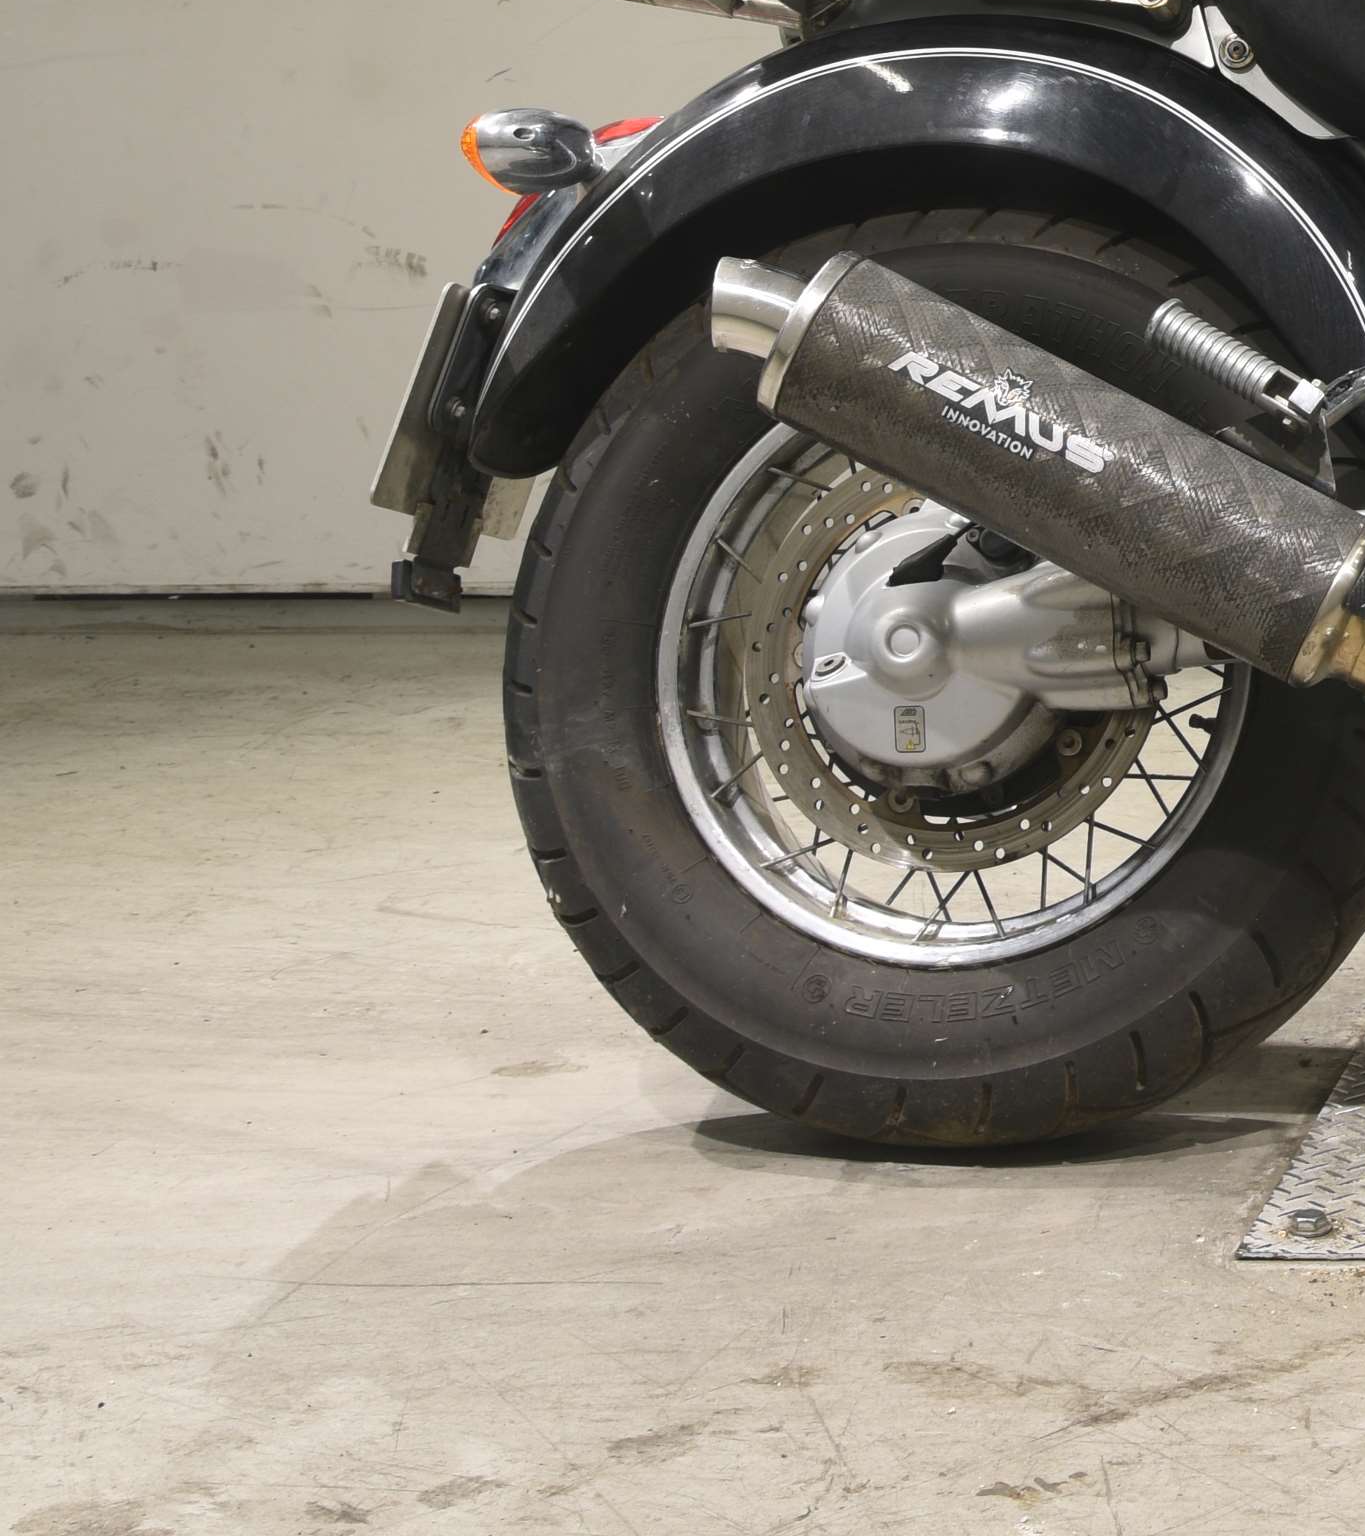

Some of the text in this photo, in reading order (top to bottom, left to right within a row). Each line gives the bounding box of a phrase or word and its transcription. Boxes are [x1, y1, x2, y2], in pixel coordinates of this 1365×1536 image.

[888, 352, 1106, 473] REMUS
[941, 406, 1033, 460] INNOVATION
[846, 944, 1125, 1022] METZELER
